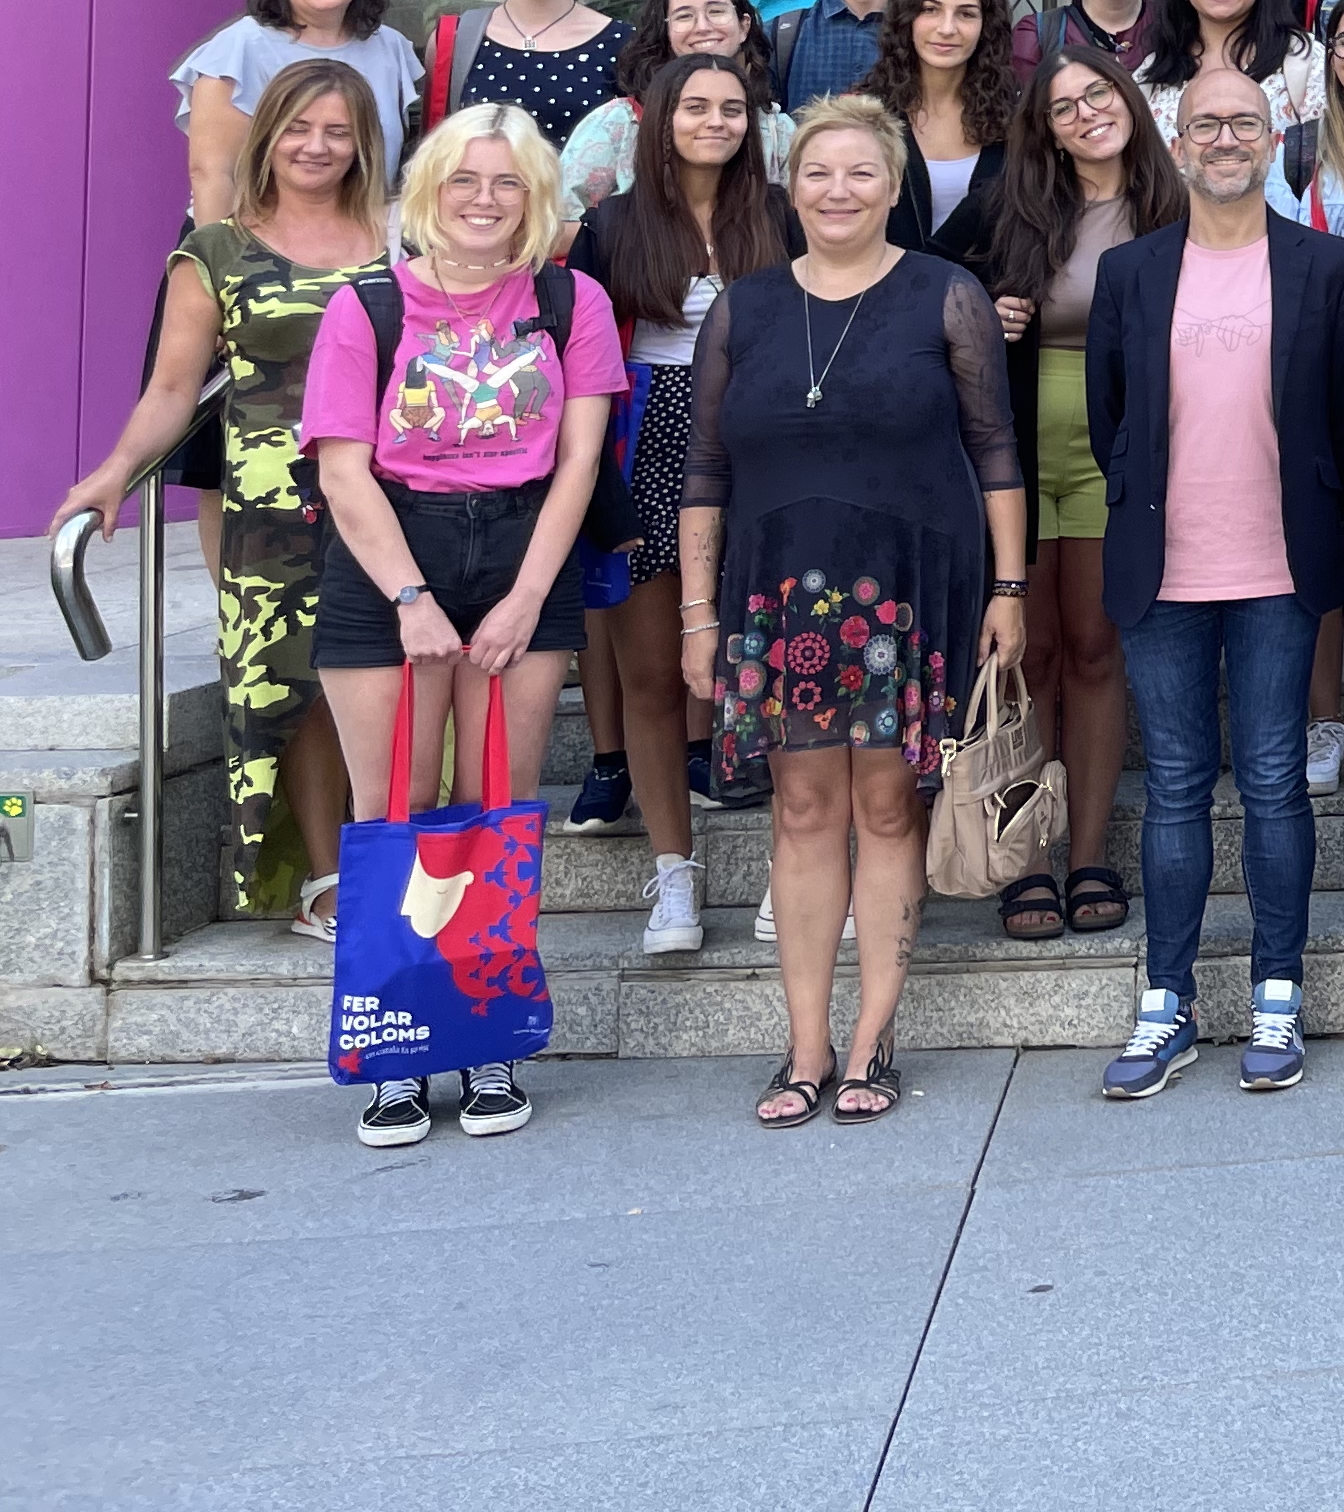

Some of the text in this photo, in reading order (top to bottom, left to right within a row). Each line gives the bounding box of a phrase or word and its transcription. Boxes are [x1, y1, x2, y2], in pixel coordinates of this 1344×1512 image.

[343, 995, 380, 1013] FER
[342, 1011, 413, 1031] VOLAR
[339, 1026, 430, 1050] COLOMS
